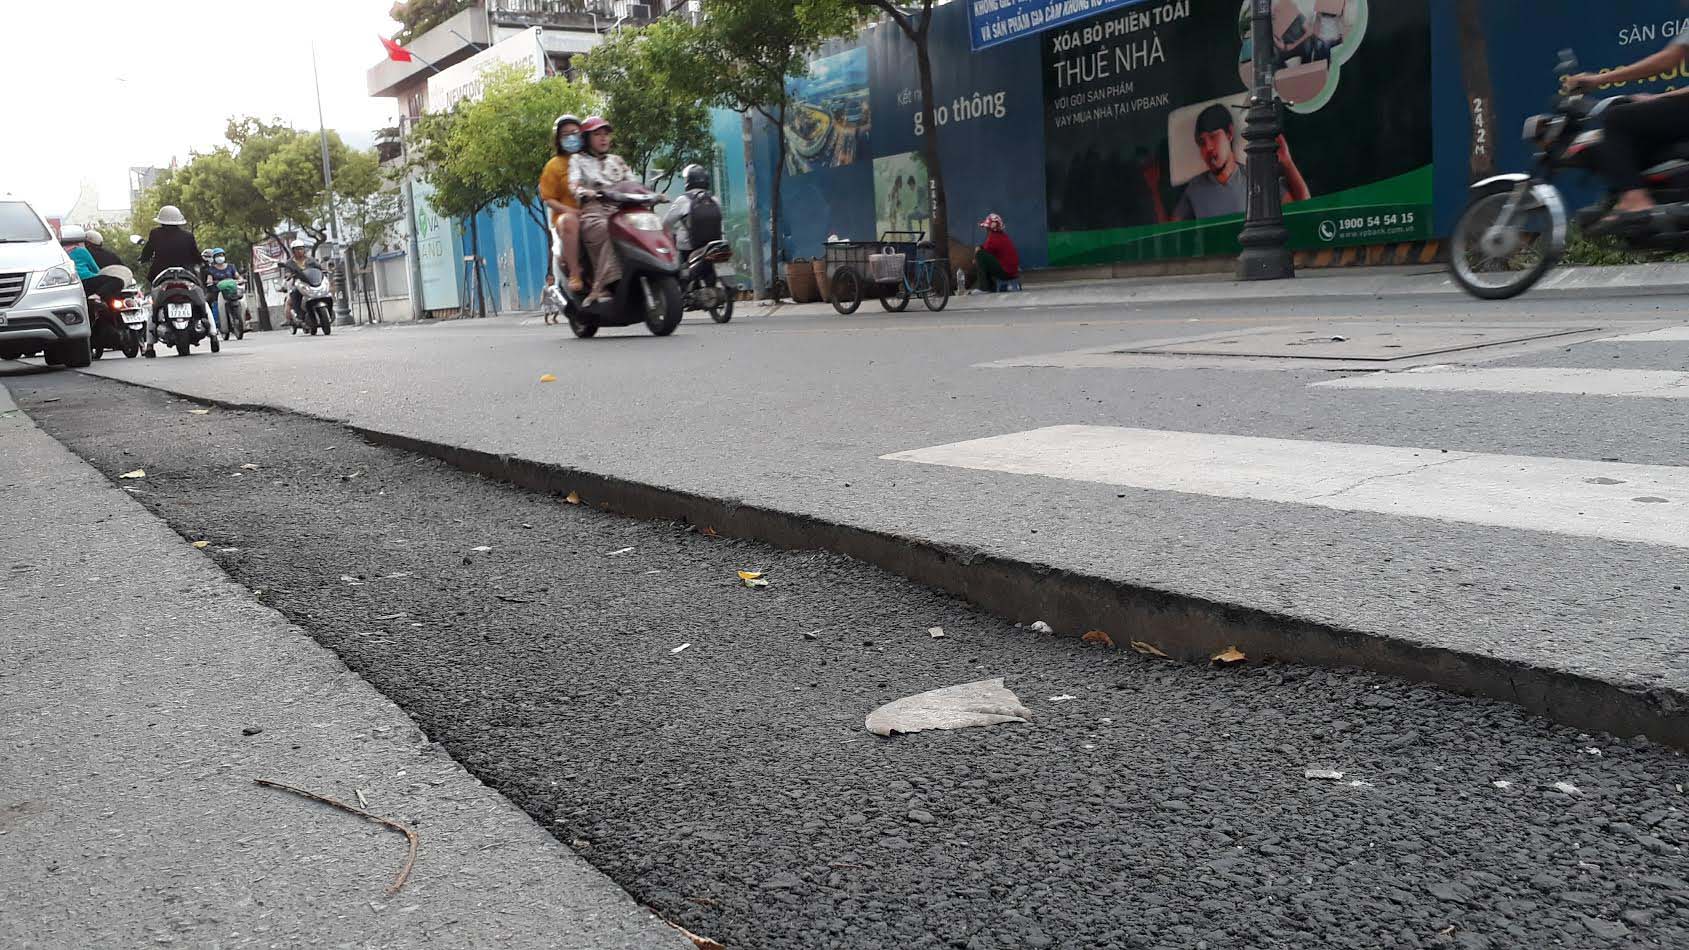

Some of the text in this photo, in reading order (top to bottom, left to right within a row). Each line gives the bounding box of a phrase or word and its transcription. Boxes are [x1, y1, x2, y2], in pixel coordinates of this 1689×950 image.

[992, 16, 1008, 39] SẢN
[1008, 8, 1031, 34] PHẨM
[1031, 9, 1044, 27] GIA
[1053, 30, 1081, 53] XÓA
[1083, 21, 1103, 45] BỎ
[1105, 11, 1150, 38] PHIỀN
[1618, 24, 1656, 46] SÀN
[1053, 30, 1165, 88] THUÊ NHÀ
[914, 106, 948, 136] go
[952, 91, 1006, 122] thông
[1130, 92, 1170, 112] VPBANK
[1339, 212, 1414, 230] 1900 54 54 15
